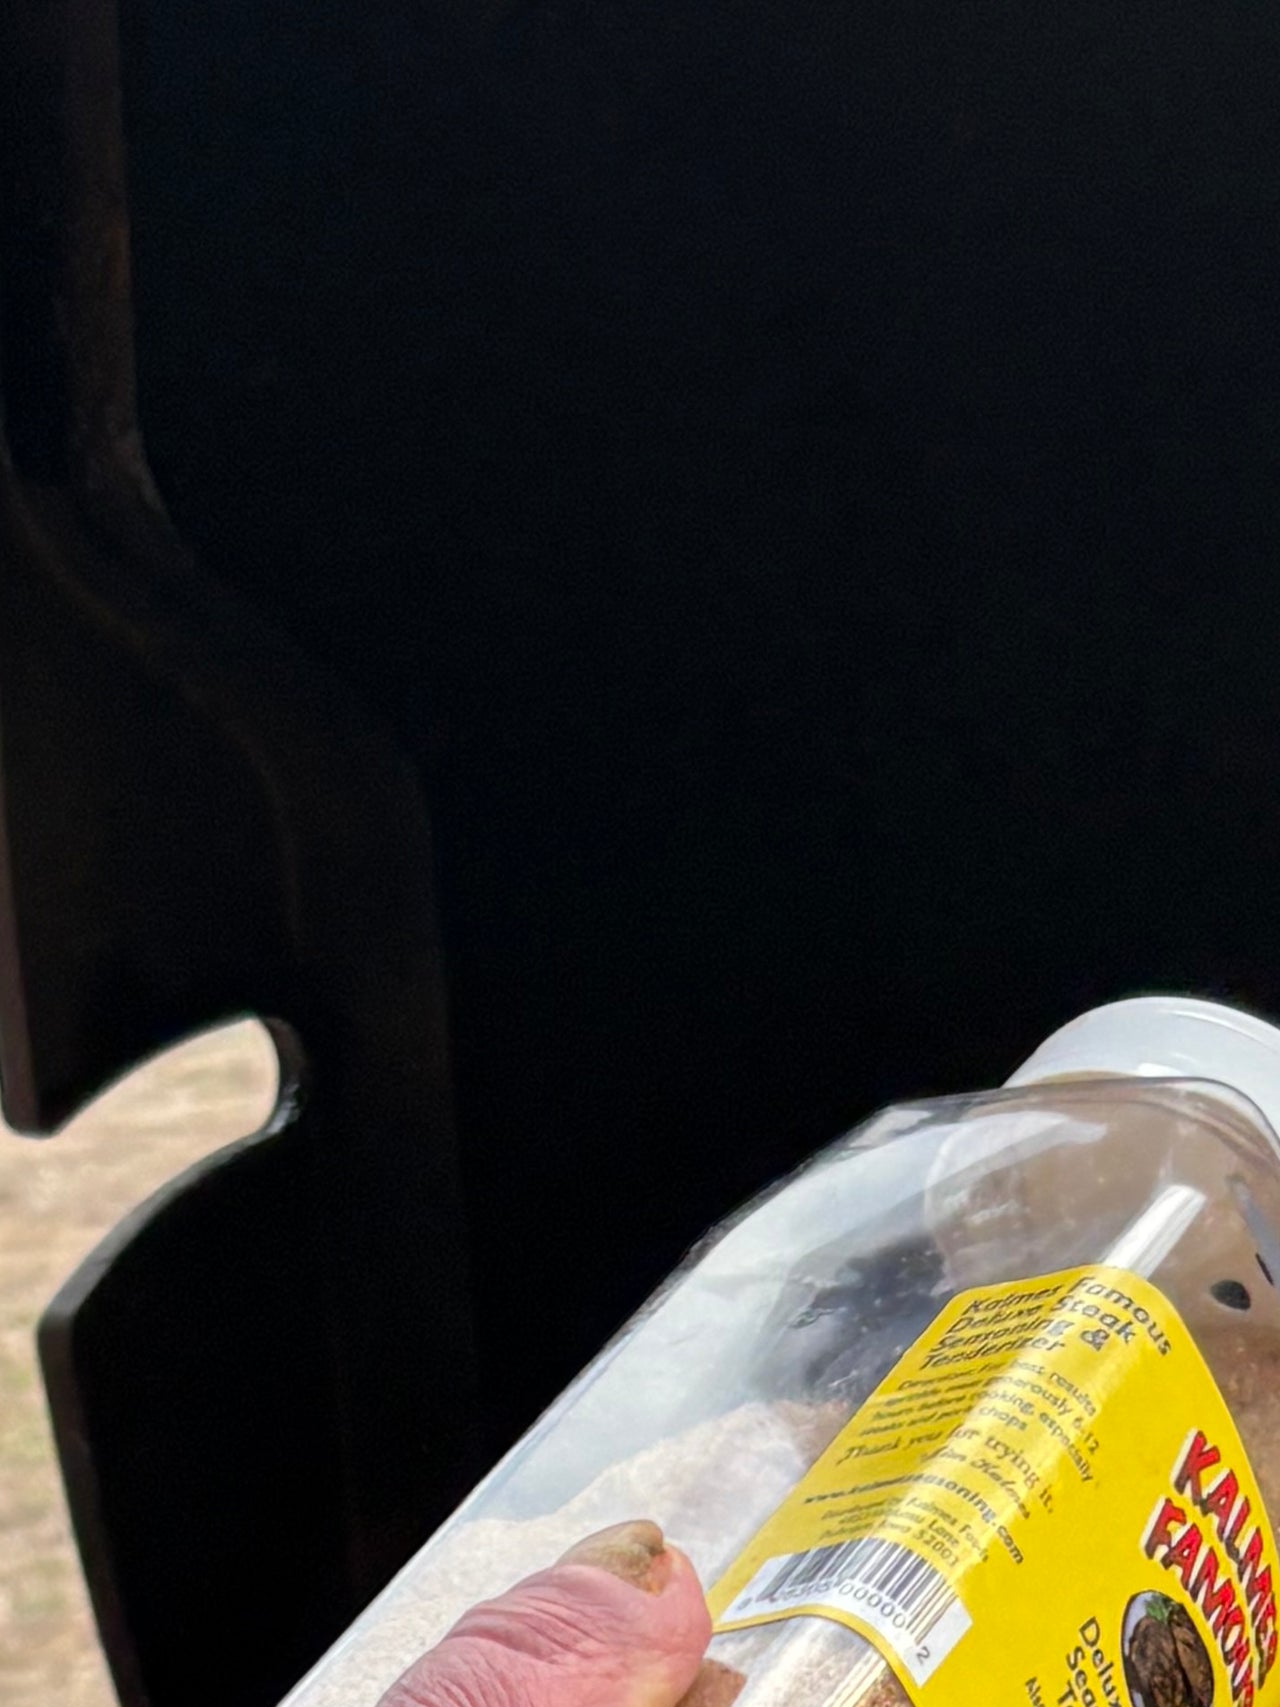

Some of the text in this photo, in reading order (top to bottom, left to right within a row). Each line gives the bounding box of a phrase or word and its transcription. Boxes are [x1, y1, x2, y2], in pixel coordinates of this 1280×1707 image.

[931, 1318, 1110, 1353] Seasoning &
[946, 1295, 1136, 1344] Deluxe Steak
[962, 1276, 1172, 1356] Kalmes Famous
[919, 1337, 1066, 1371] Tenderizer
[1049, 1371, 1097, 1417] results
[978, 1405, 1028, 1431] chops
[835, 1436, 902, 1466] Thank
[902, 1431, 944, 1451] you
[984, 1436, 1041, 1490] trying
[1038, 1412, 1094, 1483] especially
[1170, 1426, 1278, 1690] KALMES
[914, 1645, 931, 1664] 2
